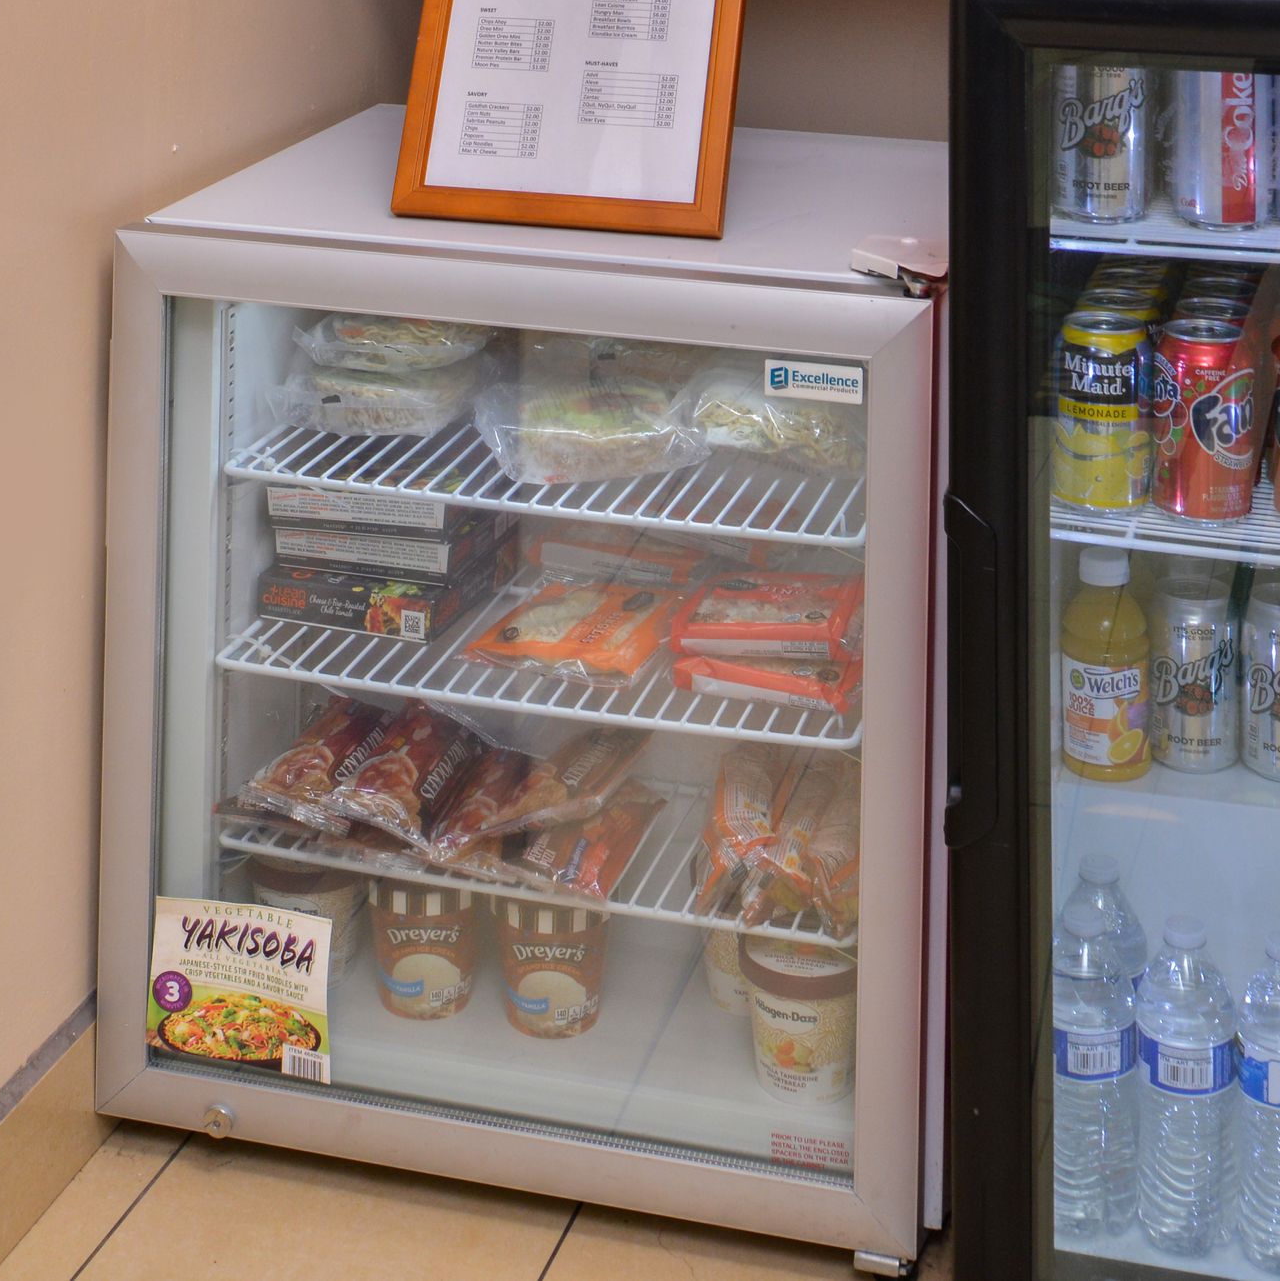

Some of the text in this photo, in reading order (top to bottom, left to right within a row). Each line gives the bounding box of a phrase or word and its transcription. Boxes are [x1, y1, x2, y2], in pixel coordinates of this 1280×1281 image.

[585, 60, 619, 68] MUST-HAVES
[1060, 78, 1145, 152] Barq's
[1073, 181, 1131, 192] ROOT BEER
[1064, 351, 1132, 378] Minute
[1194, 368, 1227, 377] CAFFEINE
[792, 370, 859, 388] Excellence
[1071, 372, 1126, 396] Maid
[792, 383, 859, 395] Commercial Products
[1066, 403, 1128, 419] LEMONADE
[1154, 638, 1234, 705] Barq's
[1087, 671, 1139, 695] Welch's
[1167, 734, 1223, 748] ROOT BEER
[203, 905, 293, 929] VEGETABLE
[386, 925, 461, 945] Dreyer's
[181, 915, 316, 976] YAKISOBA
[512, 943, 587, 962] Dreyer's
[164, 981, 181, 1003] 3
[184, 968, 203, 978] CRISP
[205, 970, 242, 985] VEGETABLES
[243, 977, 256, 987] AND
[262, 982, 284, 997] SAVORY
[285, 989, 305, 1002] SAUCE
[754, 995, 819, 1024] Häagen-Dazs
[771, 1133, 846, 1149] PRIOR TO USE PLEASE
[771, 1140, 850, 1158] INSTALL THE ENCLOSED
[771, 1149, 849, 1165] SPACERS ON THE REAR
